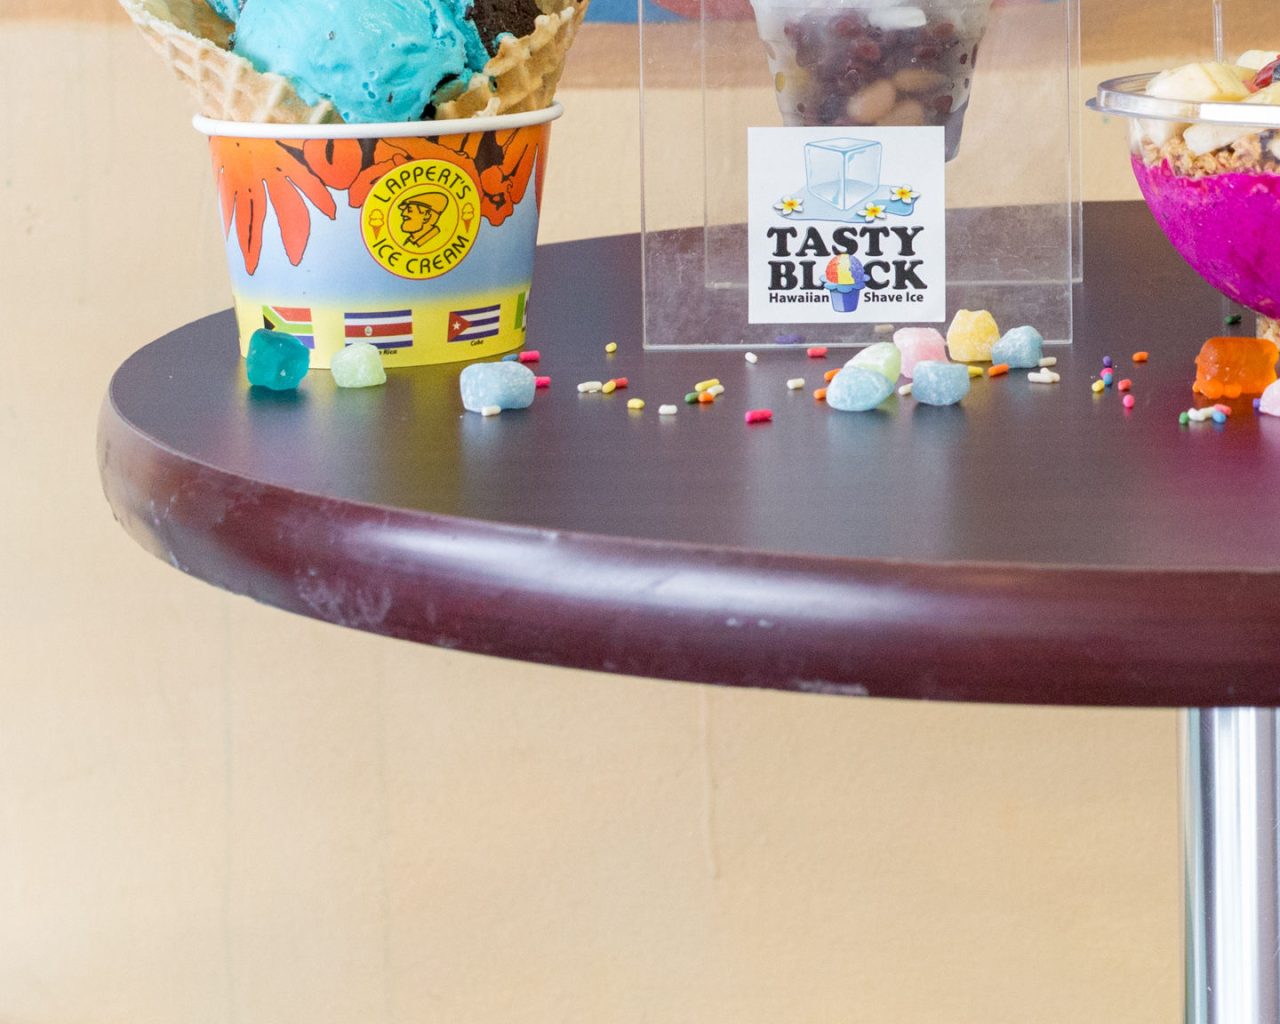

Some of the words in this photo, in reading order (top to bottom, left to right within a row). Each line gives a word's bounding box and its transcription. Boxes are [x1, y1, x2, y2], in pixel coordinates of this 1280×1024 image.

[373, 165, 472, 203] LAPPERT'S
[372, 237, 403, 267] ICE
[405, 234, 470, 274] CREAM
[766, 226, 925, 257] TASTY
[767, 259, 928, 291] BLCK
[768, 291, 830, 304] Hawaiian
[863, 291, 903, 303] Shave
[906, 291, 924, 303] Ice
